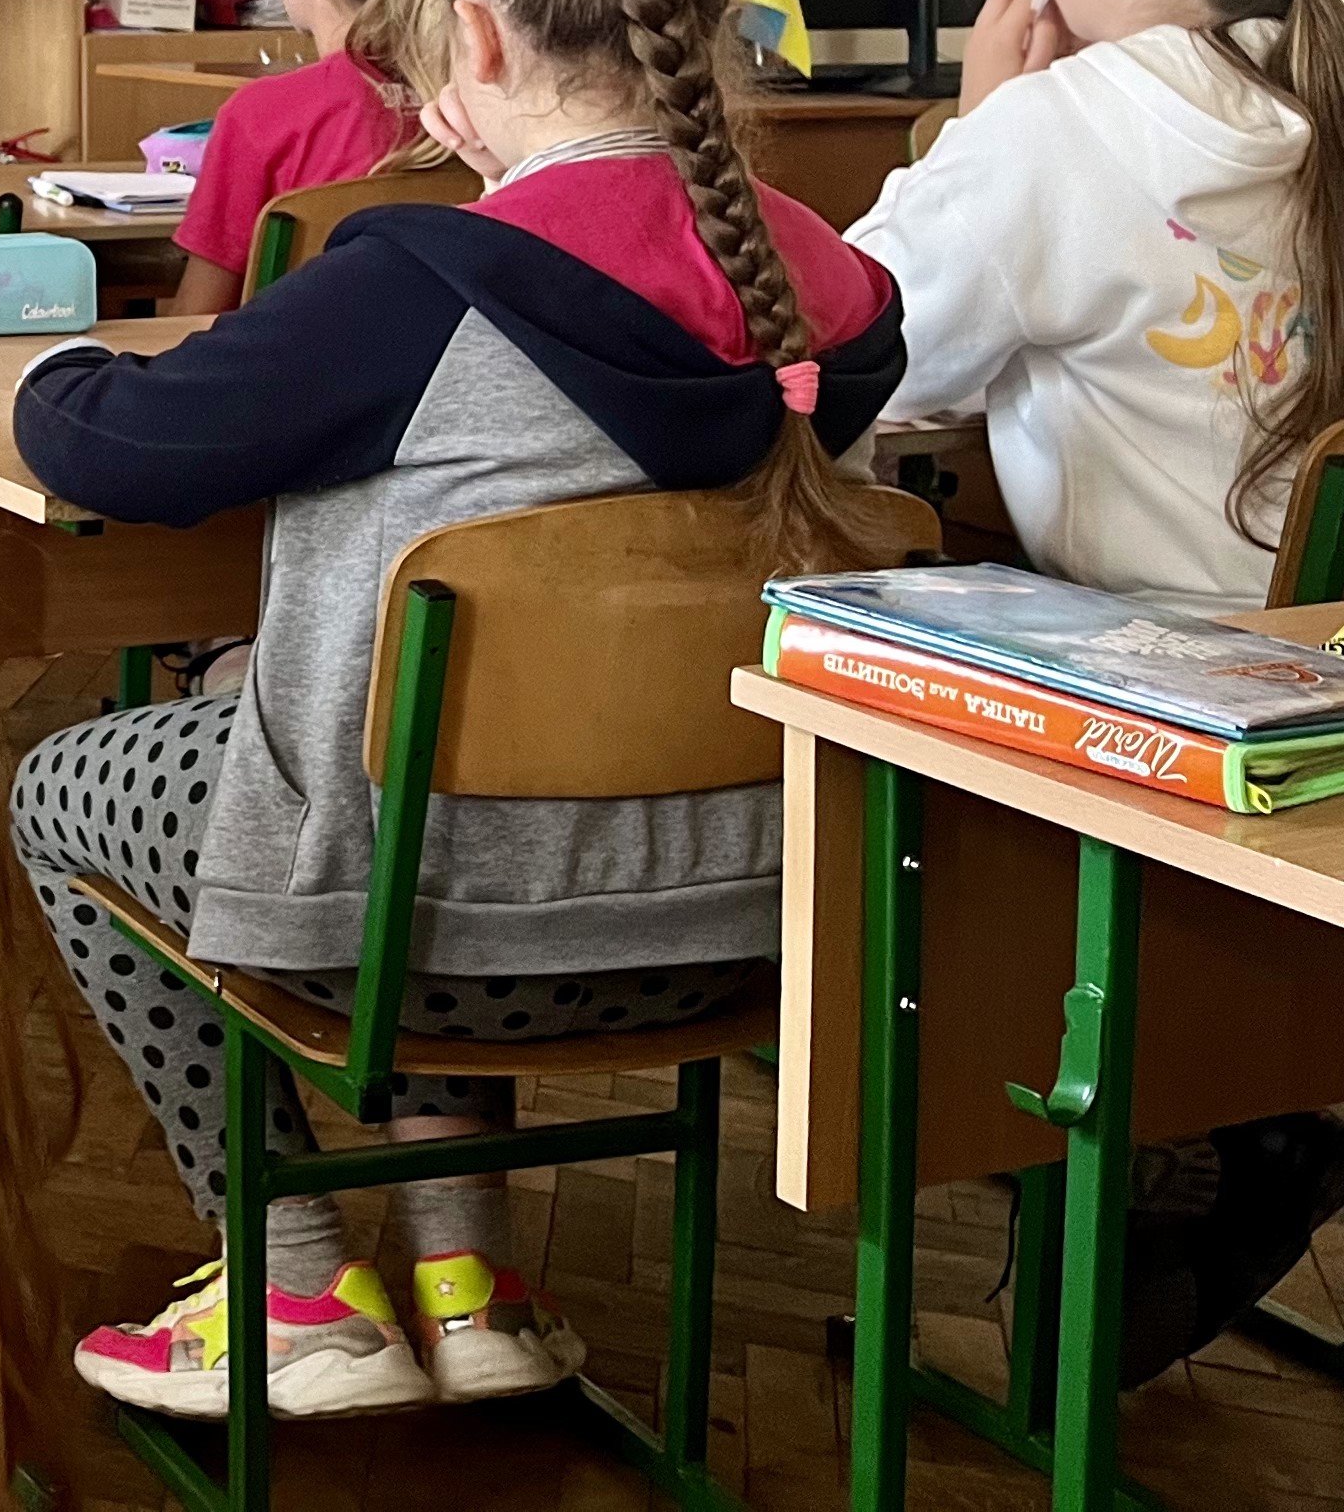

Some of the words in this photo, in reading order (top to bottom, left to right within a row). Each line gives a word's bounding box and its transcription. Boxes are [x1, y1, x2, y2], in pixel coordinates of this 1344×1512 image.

[823, 653, 925, 701] ЗОШИТІВ
[964, 692, 1046, 734] ПАПКА
[1074, 717, 1188, 783] World
